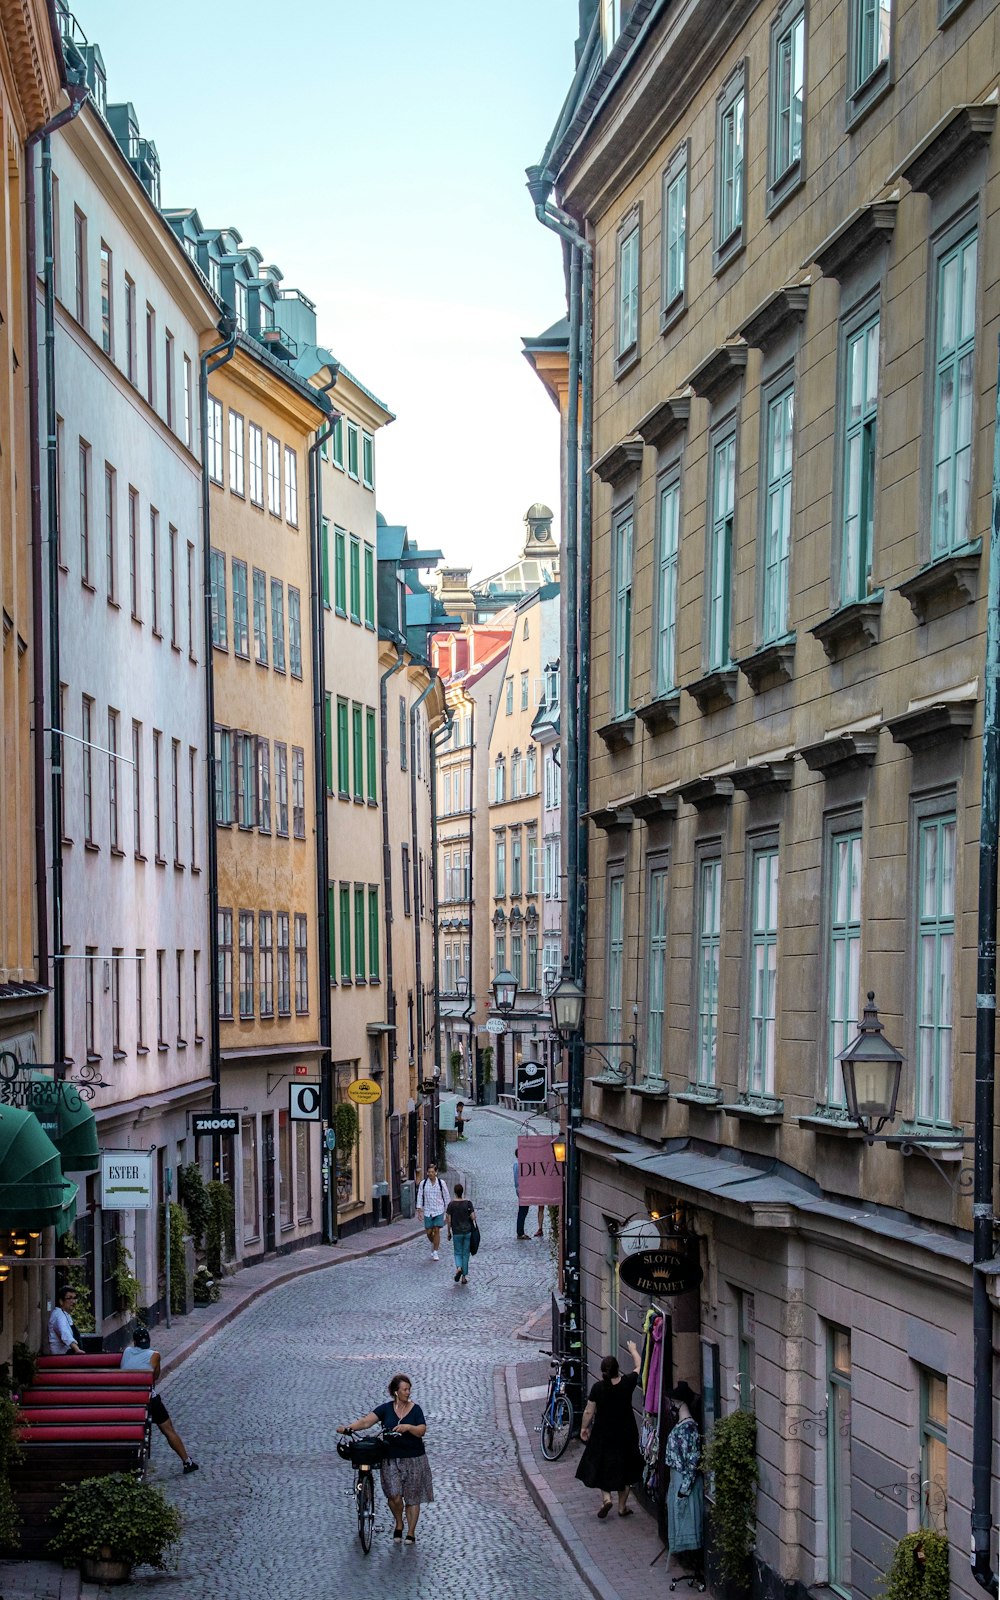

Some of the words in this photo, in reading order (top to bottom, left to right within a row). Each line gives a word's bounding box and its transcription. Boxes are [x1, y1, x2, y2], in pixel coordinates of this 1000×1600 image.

[527, 1065, 535, 1073] 37
[196, 1119, 236, 1130] ZNOGG
[109, 1165, 139, 1179] ESTER
[520, 1161, 562, 1177] DIVA
[643, 1254, 681, 1265] SLOTTS
[637, 1277, 685, 1292] HEMMET
